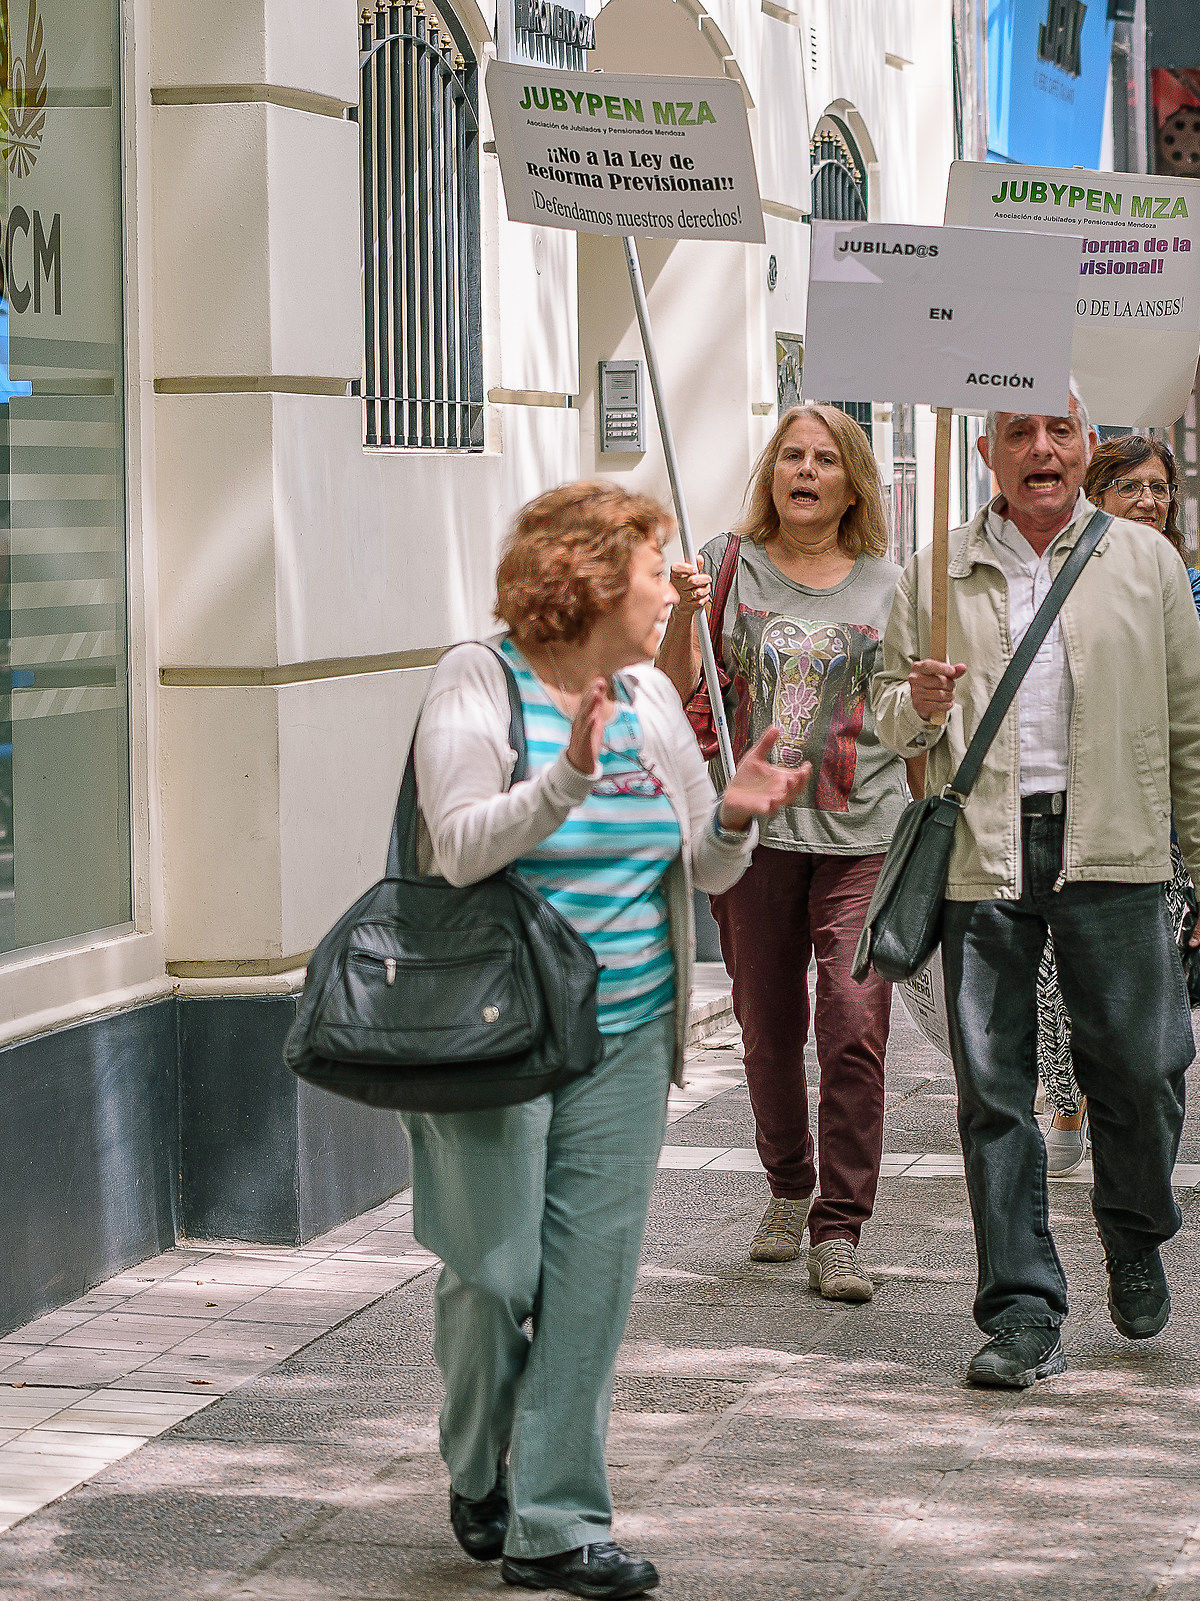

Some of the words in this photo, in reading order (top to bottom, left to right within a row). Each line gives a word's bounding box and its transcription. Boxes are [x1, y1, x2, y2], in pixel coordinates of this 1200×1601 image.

[519, 86, 644, 123] JUBYPEN
[652, 101, 717, 126] MZA
[526, 119, 560, 130] Asociación
[570, 125, 601, 134] Jubilados
[608, 127, 653, 136] Pensionados
[654, 129, 686, 137] Mendoza
[547, 147, 580, 165] ¡¡No
[586, 150, 599, 166] a
[603, 150, 623, 167] la
[631, 150, 662, 171] Ley
[670, 154, 695, 171] de
[526, 162, 603, 189] Reforma
[607, 172, 735, 192] Previsional!!
[531, 189, 613, 226] ¡Defendamos
[616, 206, 674, 229] nuestros
[677, 205, 742, 229] derechos!
[991, 181, 1122, 215] JUBYPEN
[1131, 195, 1189, 219] MZA
[994, 211, 1032, 221] Asociación
[1043, 216, 1076, 225] Jubilados
[1083, 218, 1126, 228] Pensionados
[1127, 221, 1157, 229] Mendoza
[838, 240, 939, 259] JUBILAD@S
[1143, 236, 1169, 253] de
[1172, 237, 1191, 253] la
[0, 205, 62, 316] CM
[929, 307, 954, 321] EN
[1090, 299, 1110, 317] DE
[1113, 300, 1136, 317] LA
[1135, 296, 1185, 317] ANSES!
[966, 370, 1035, 390] ACCIÓN
